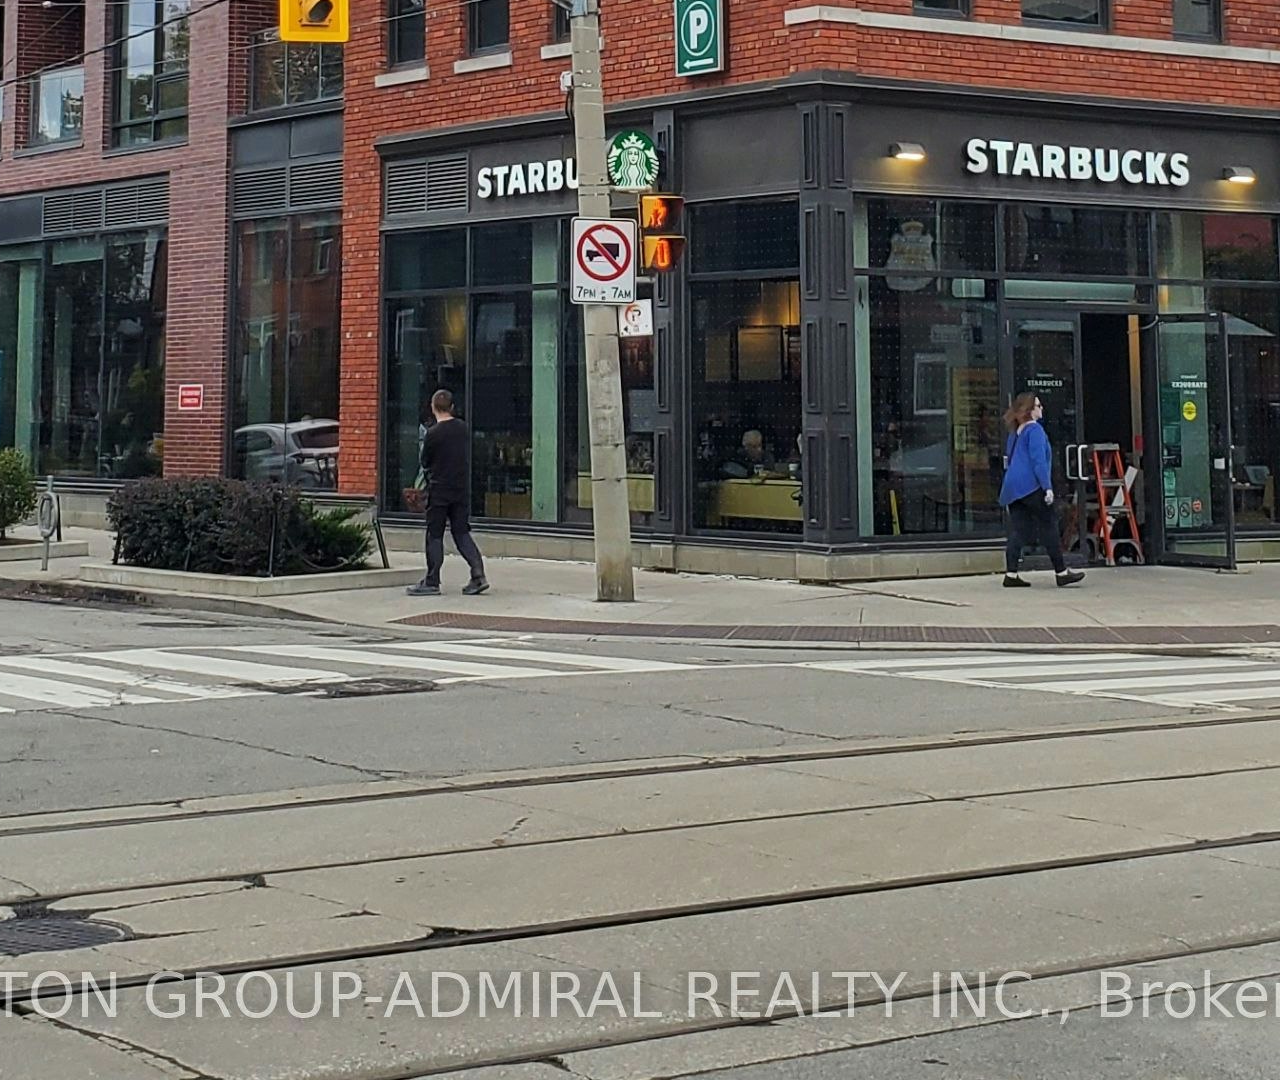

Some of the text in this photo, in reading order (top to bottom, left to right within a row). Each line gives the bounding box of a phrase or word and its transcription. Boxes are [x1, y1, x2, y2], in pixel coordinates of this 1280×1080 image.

[689, 8, 709, 50] P
[477, 157, 579, 199] STARBU
[966, 138, 1190, 187] STARBUCKS
